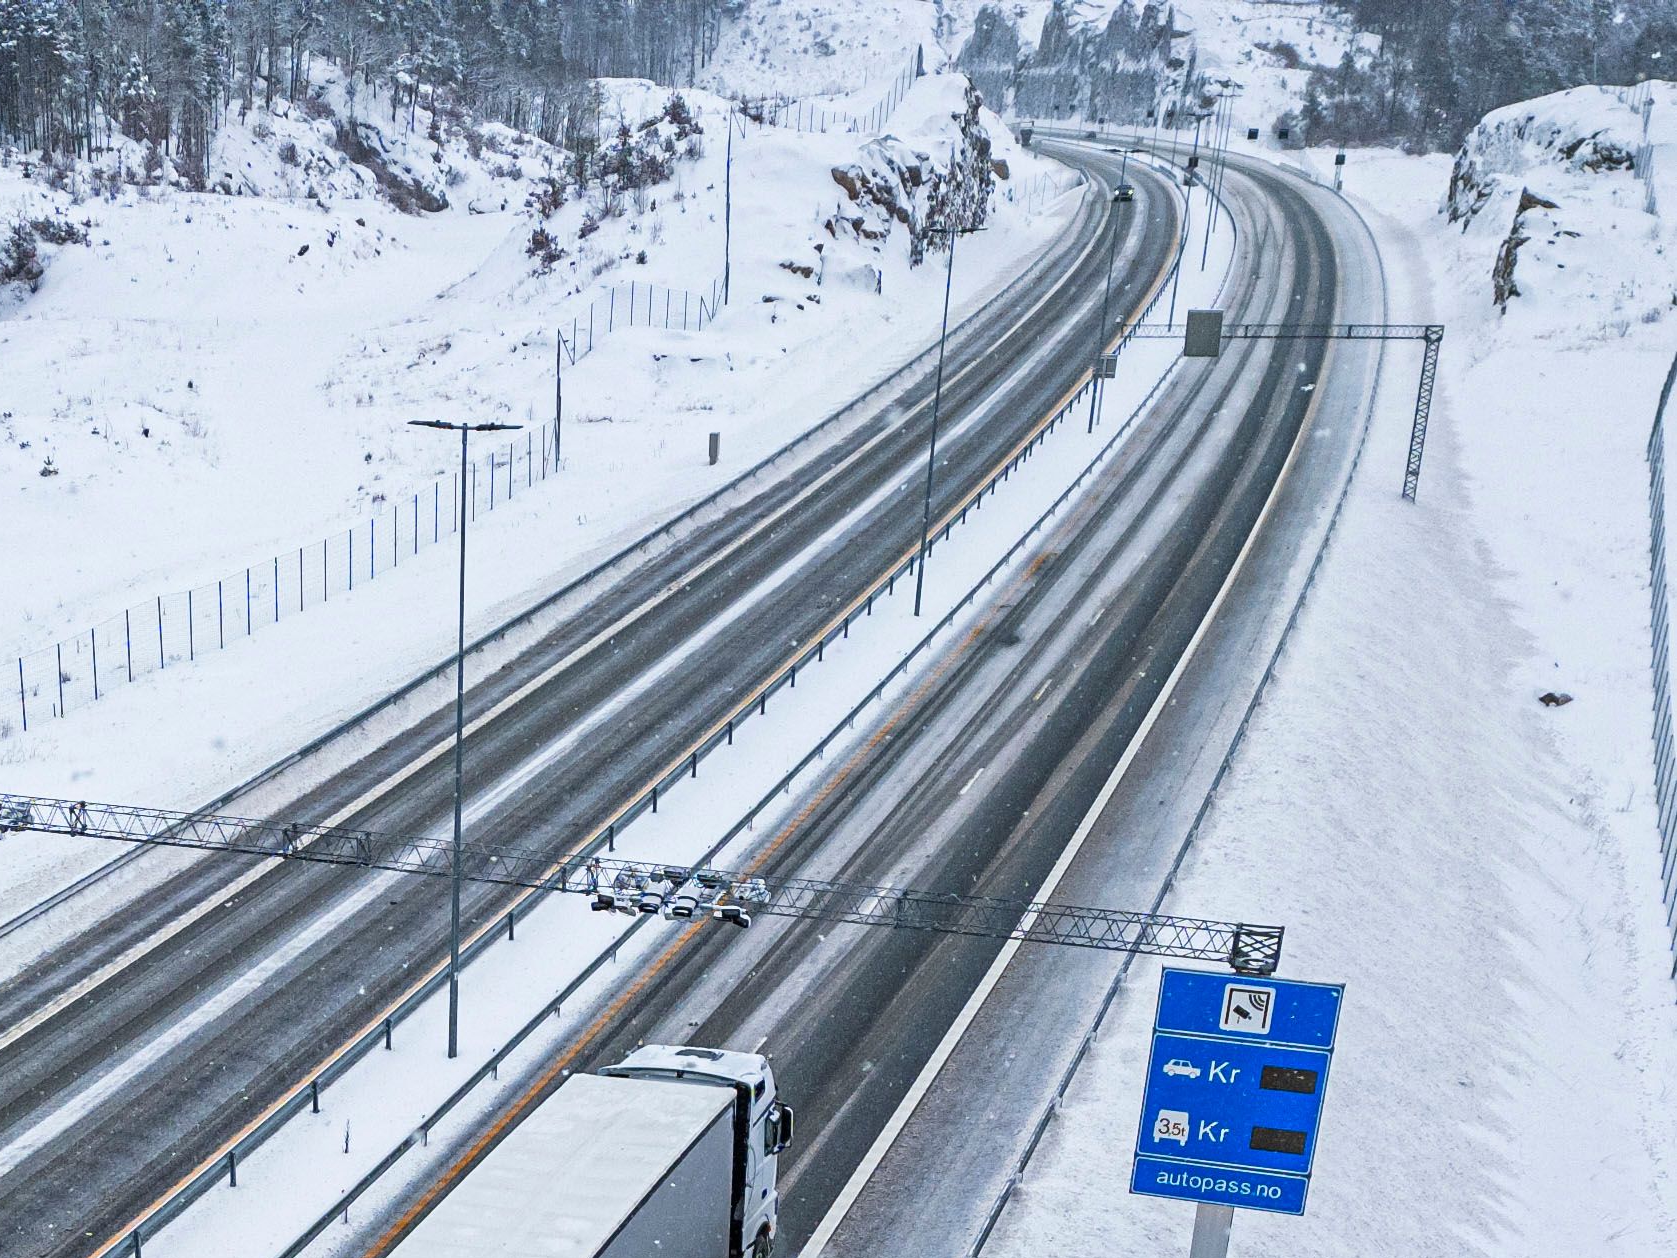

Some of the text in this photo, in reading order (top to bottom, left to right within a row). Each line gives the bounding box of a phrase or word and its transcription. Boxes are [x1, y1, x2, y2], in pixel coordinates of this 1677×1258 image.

[1208, 1060, 1241, 1084] Kr
[1198, 1120, 1229, 1143] Kr
[1156, 1171, 1282, 1199] autopass.no
